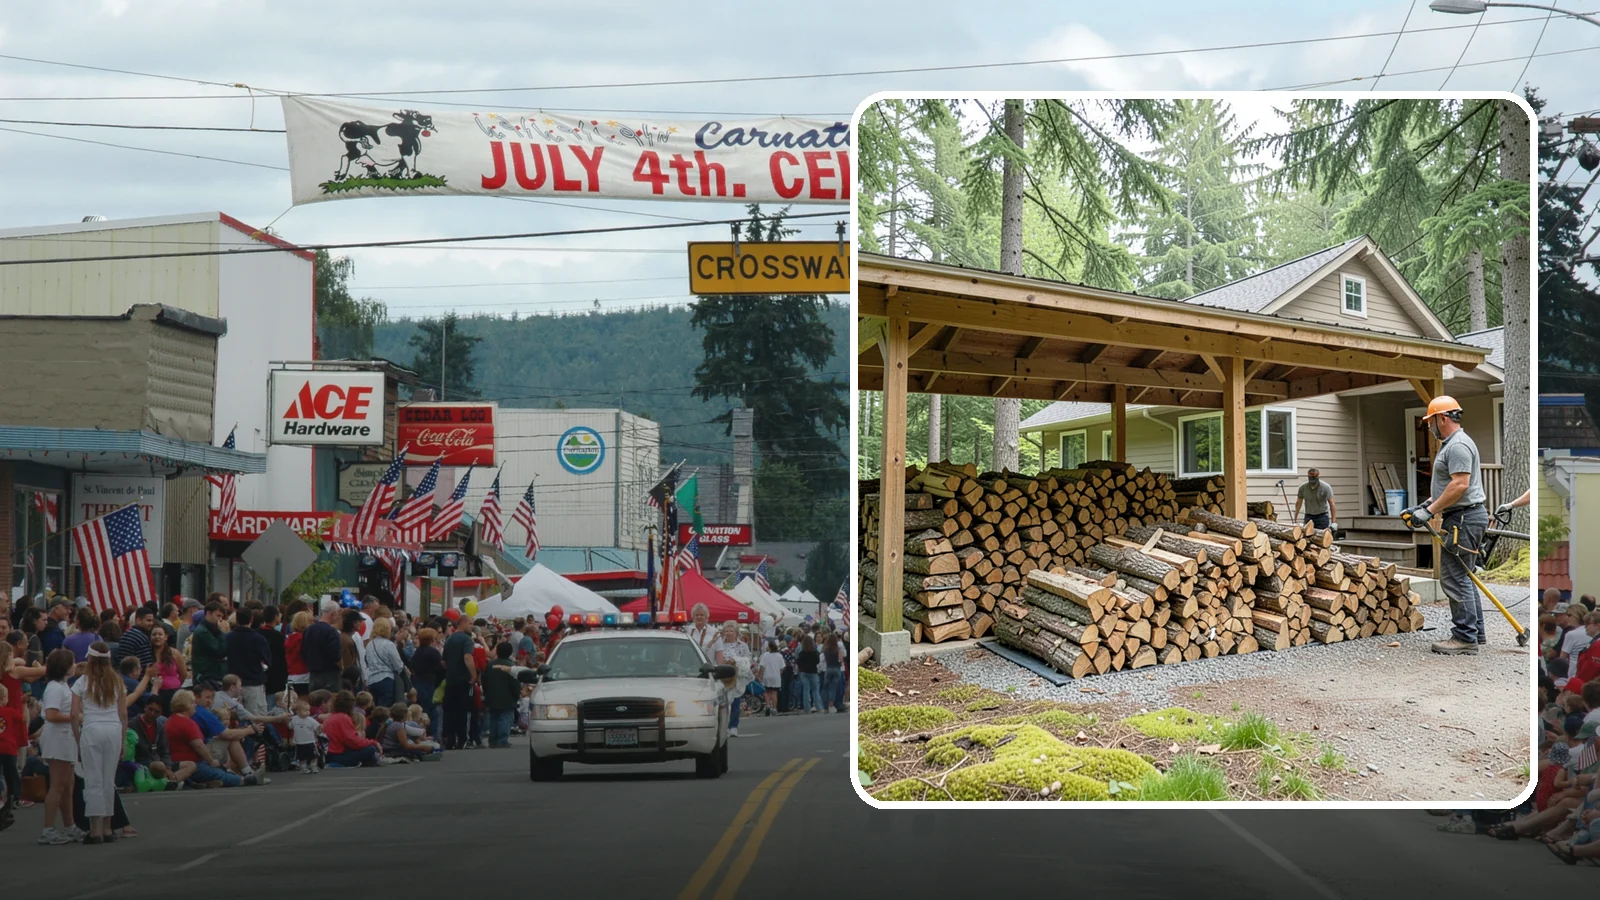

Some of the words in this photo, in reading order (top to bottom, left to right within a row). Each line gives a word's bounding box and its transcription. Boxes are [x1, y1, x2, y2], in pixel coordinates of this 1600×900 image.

[695, 121, 850, 150] Carnat
[481, 141, 605, 192] JULY
[632, 149, 746, 198] 4th.
[697, 254, 850, 280] CROSSWA
[283, 380, 373, 420] ACE
[405, 409, 452, 422] CEDAR
[283, 421, 370, 437] Hardware
[416, 428, 477, 447] Coca-Cola
[353, 467, 385, 480] Simpl
[83, 485, 93, 495] St.
[96, 485, 124, 495] Vincent
[126, 486, 136, 495] de
[137, 486, 155, 495] Paul
[688, 526, 741, 535] CRNATION
[699, 535, 730, 543] GLASS
